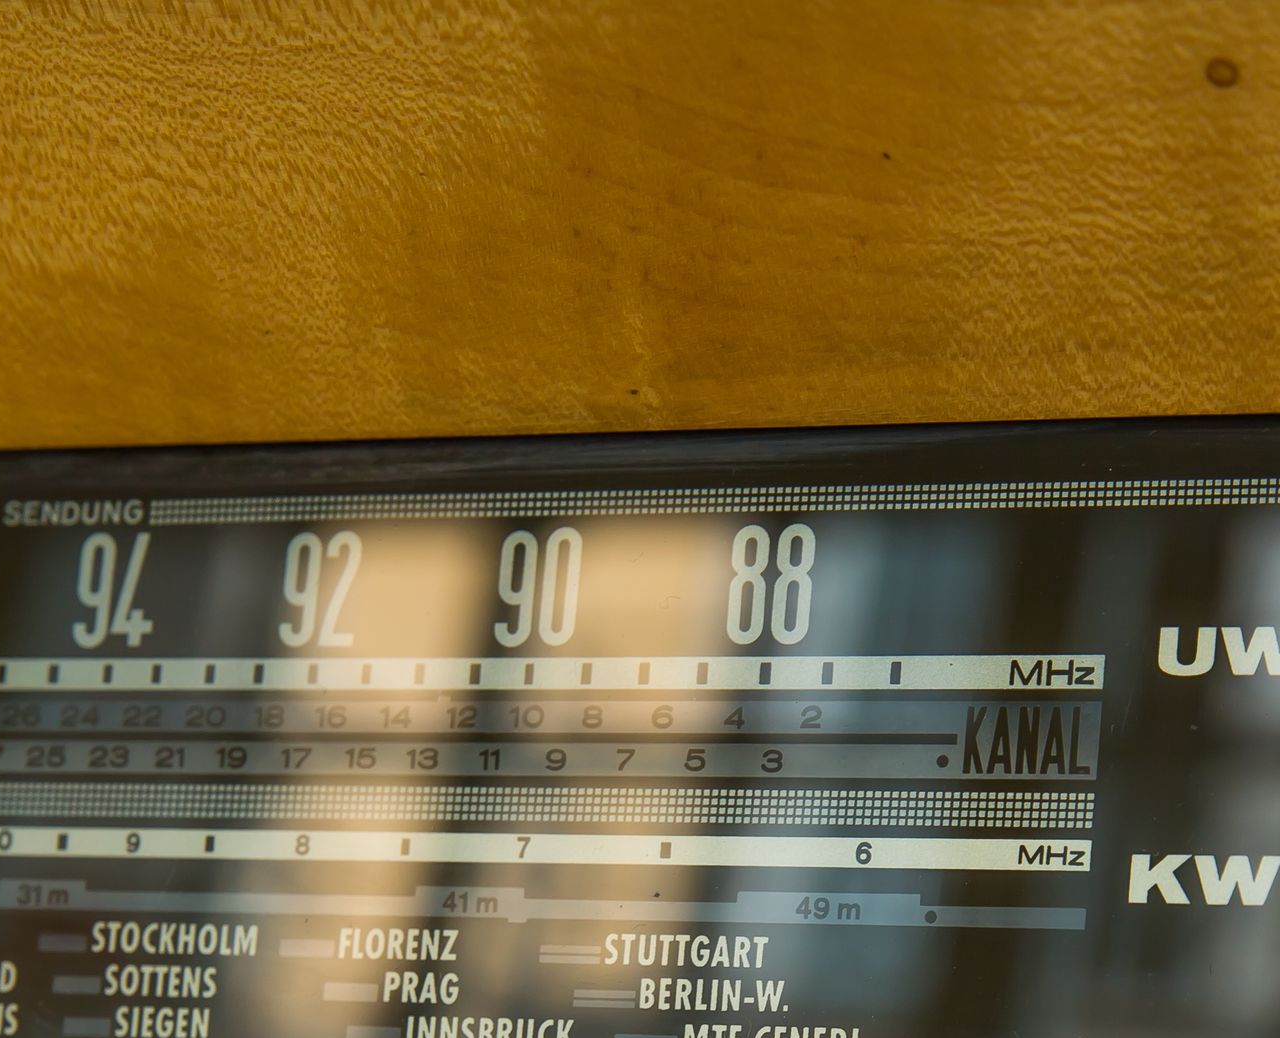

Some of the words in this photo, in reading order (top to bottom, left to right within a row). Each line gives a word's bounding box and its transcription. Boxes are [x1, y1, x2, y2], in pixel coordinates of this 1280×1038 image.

[2, 499, 144, 526] SENDUNG
[72, 532, 153, 648] 94
[279, 531, 362, 647] 92
[494, 526, 583, 647] 90
[726, 524, 816, 645] 88
[1009, 660, 1095, 686] MHz
[61, 705, 98, 727] 24
[123, 705, 164, 728] 22
[185, 705, 226, 728] 20
[255, 705, 284, 728] 18
[315, 705, 347, 728] 16
[379, 706, 411, 728] 14
[446, 706, 478, 728] 12
[509, 705, 544, 728] 10
[582, 705, 604, 729] 8
[652, 705, 674, 729] 6
[724, 706, 745, 729] 4
[800, 706, 822, 728] 2
[962, 706, 1091, 775] KANAL
[26, 745, 67, 768] 25
[89, 746, 130, 768] 23
[154, 746, 185, 768] 21
[216, 747, 248, 769] 19
[280, 747, 312, 769] 17
[344, 747, 377, 770] 15
[406, 748, 439, 770] 13
[477, 749, 501, 771] 11
[545, 748, 567, 771] 9
[616, 748, 636, 771] 7
[683, 748, 707, 772] 5
[760, 749, 784, 773] 3
[127, 833, 140, 852] 9
[294, 834, 310, 856] 8
[517, 836, 531, 859] 7
[856, 841, 872, 864] 6
[1018, 844, 1084, 867] MHz
[48, 887, 69, 906] m
[442, 891, 468, 912] 41
[476, 894, 498, 913] m
[796, 897, 830, 921] 49
[837, 901, 860, 921] m
[91, 921, 259, 957] STOCKHOLM
[338, 927, 459, 962] FLORENZ
[604, 933, 769, 970] STUTTGART
[104, 964, 217, 999] SOTTENS
[383, 971, 460, 1006] PRAG
[639, 978, 789, 1013] BERLIN-W.
